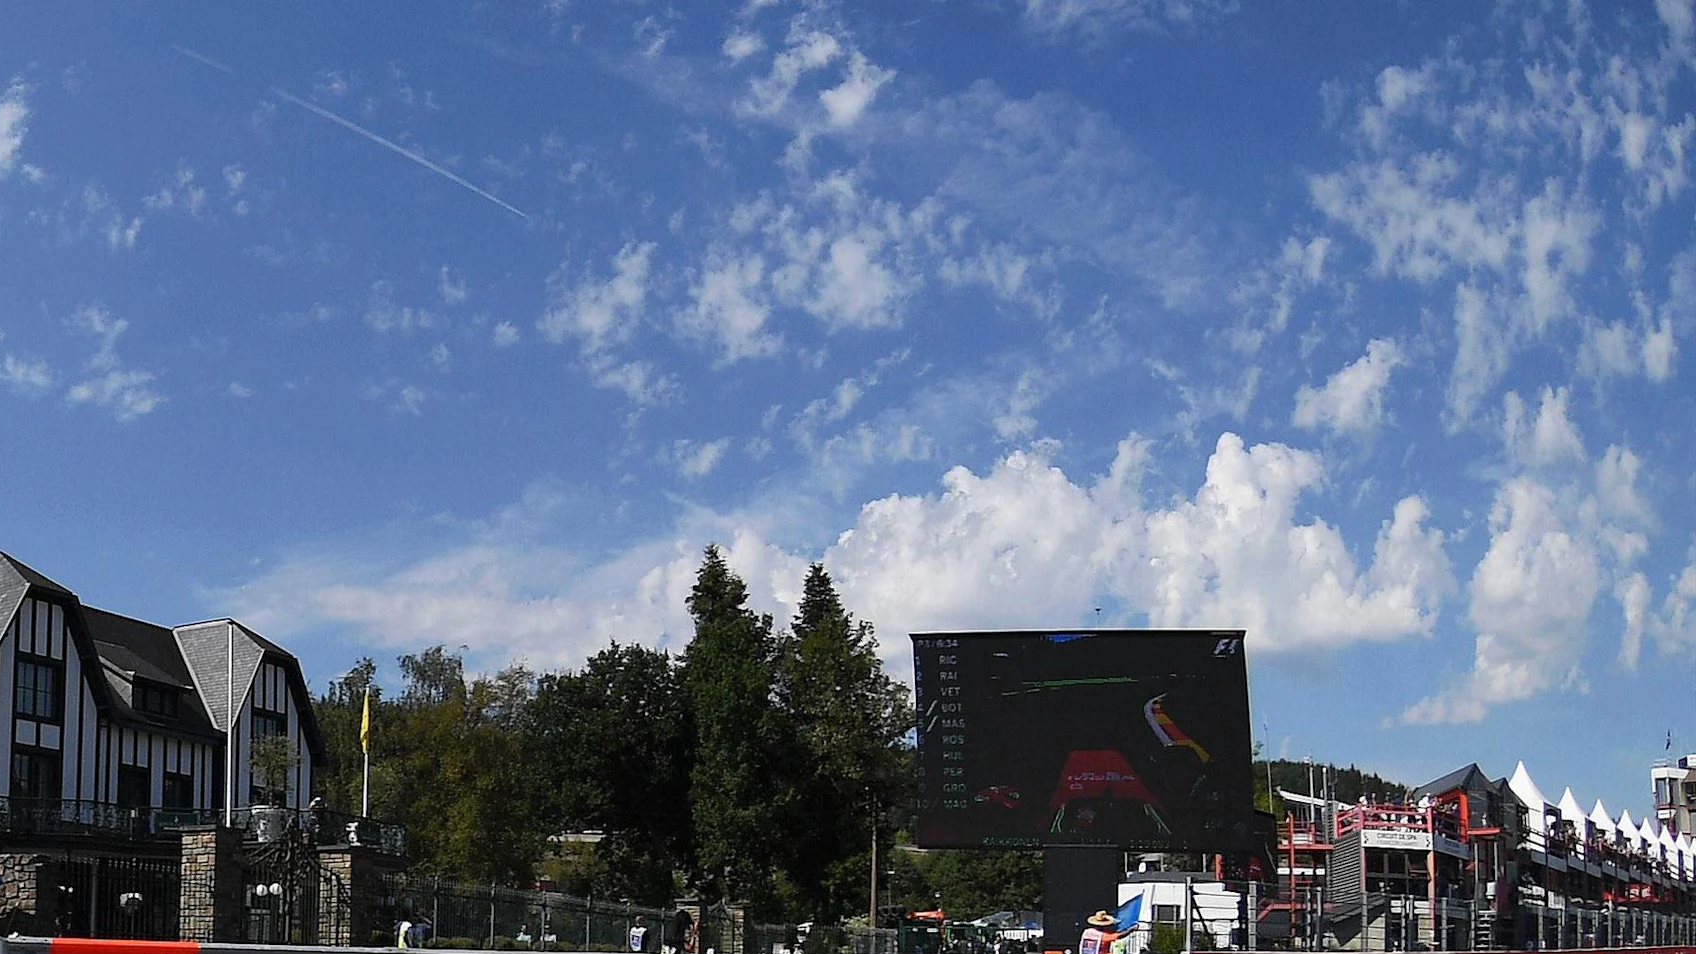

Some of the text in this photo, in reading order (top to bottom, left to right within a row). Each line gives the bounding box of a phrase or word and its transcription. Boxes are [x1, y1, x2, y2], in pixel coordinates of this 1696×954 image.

[938, 655, 958, 665] RIC
[939, 671, 958, 680] RAI
[940, 687, 961, 696] VET
